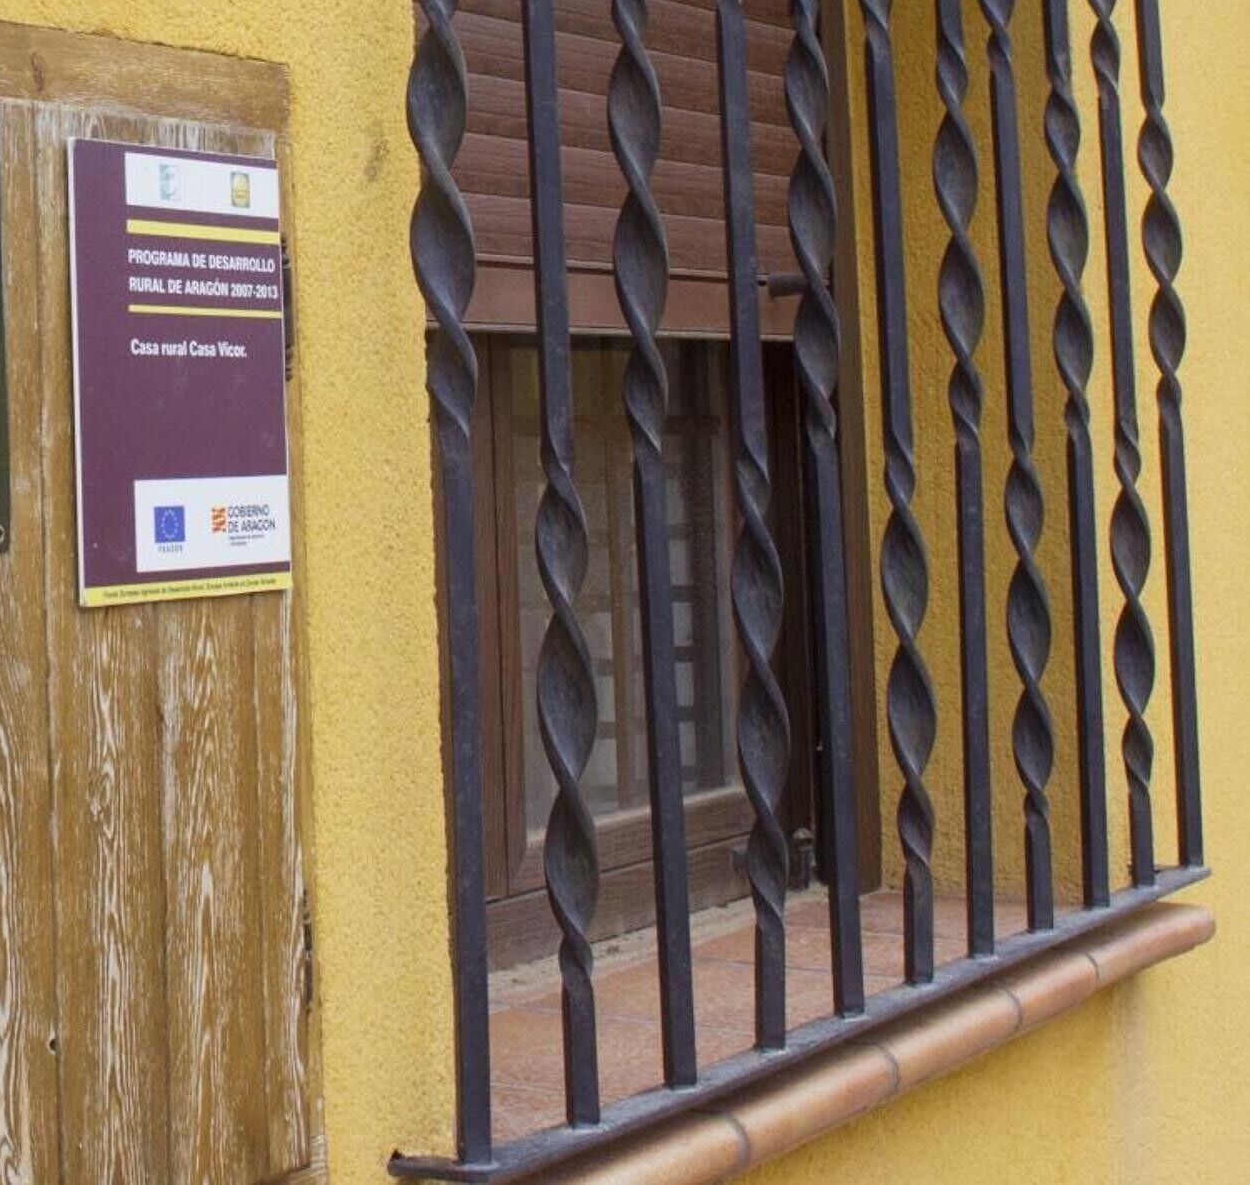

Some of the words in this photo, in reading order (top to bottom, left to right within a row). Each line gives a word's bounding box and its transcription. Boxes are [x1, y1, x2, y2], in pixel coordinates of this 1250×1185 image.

[128, 249, 190, 267] PROGRAMA
[191, 253, 207, 269] DE
[209, 254, 275, 273] DESARROLLO
[129, 276, 165, 293] RURAL
[167, 278, 184, 294] DE
[185, 278, 229, 296] ARAGÓN
[231, 284, 278, 299] 2007-2013
[130, 338, 159, 355] Casa
[161, 340, 187, 356] rural
[189, 340, 216, 356] Casa
